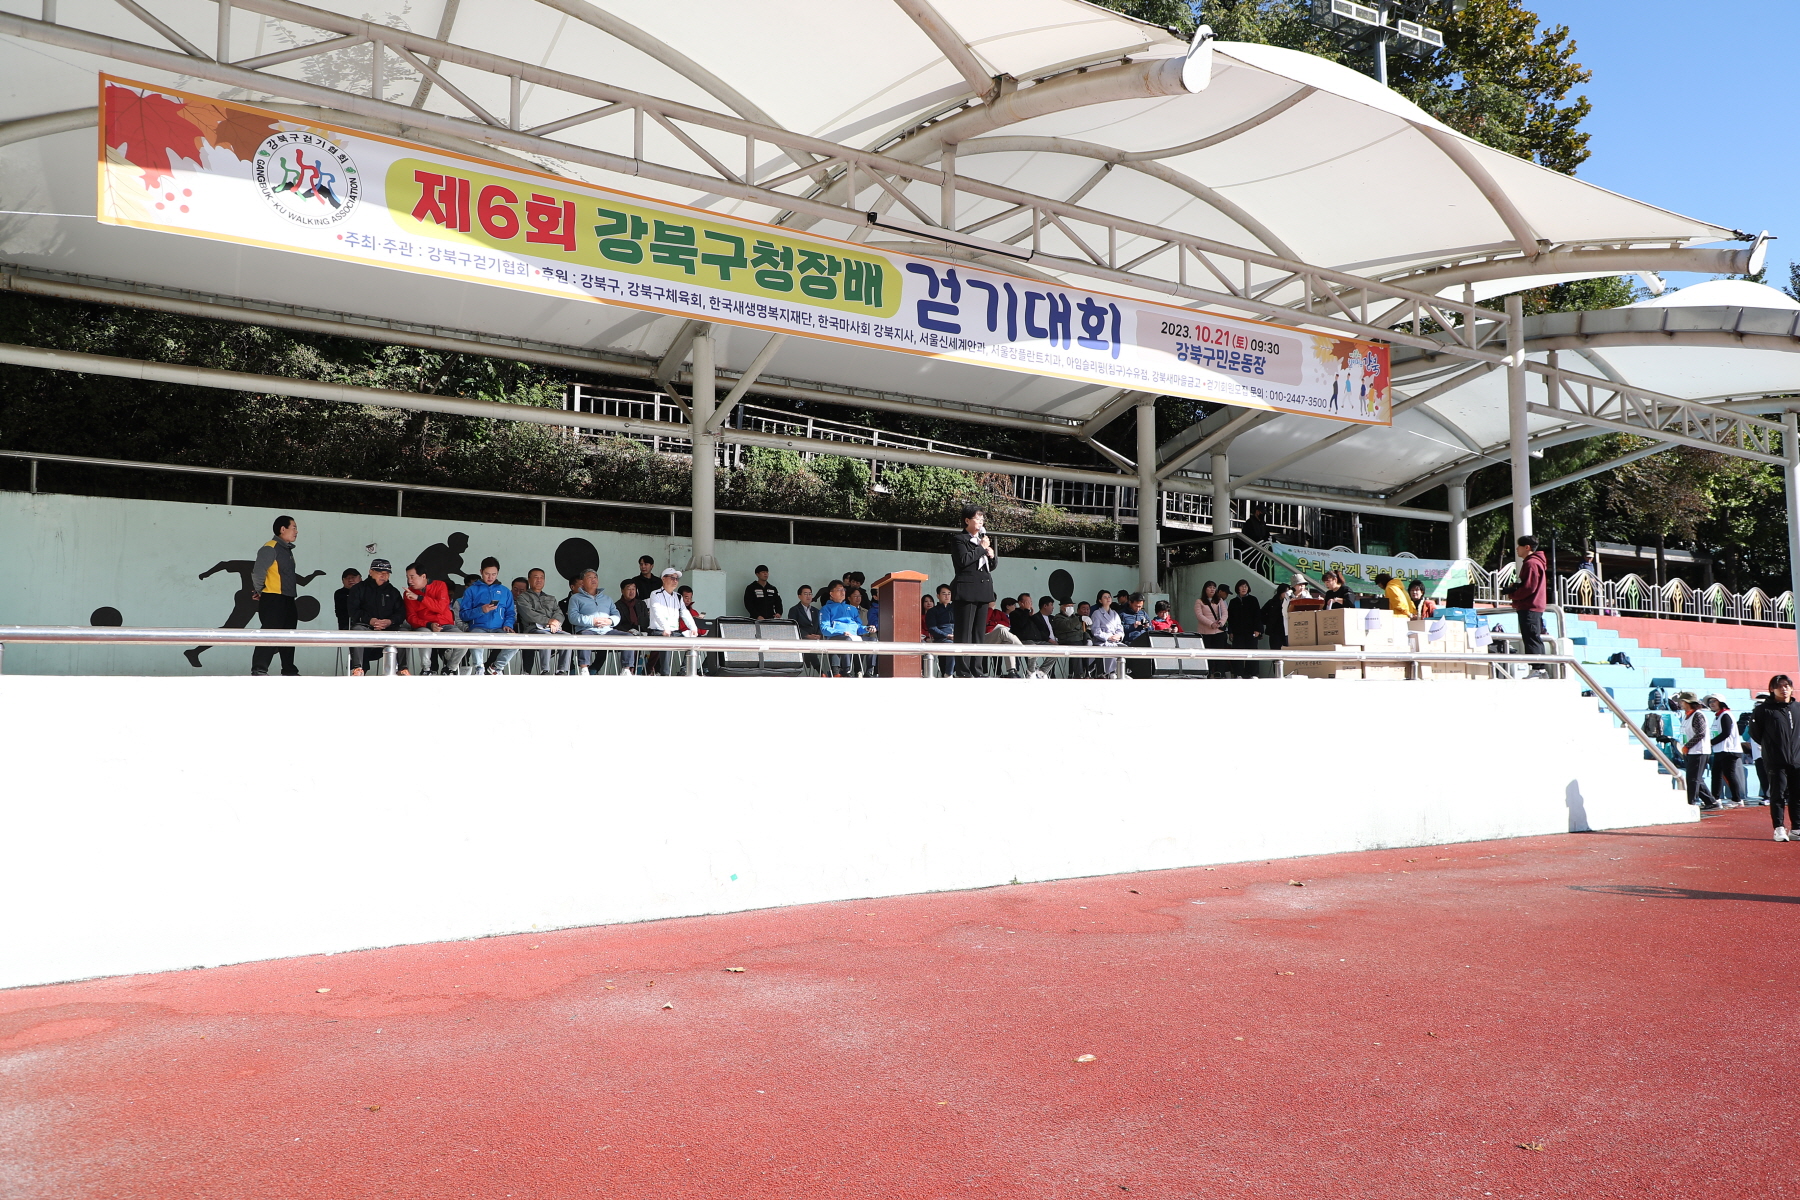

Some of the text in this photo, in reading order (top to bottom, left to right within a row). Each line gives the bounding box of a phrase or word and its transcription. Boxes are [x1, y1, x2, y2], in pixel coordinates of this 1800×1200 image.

[266, 133, 349, 164] 강북구걷기협회
[256, 158, 359, 226] GANGBUK-KU WALKING ASSOCIATION
[411, 169, 1122, 360] 제6회 강북구청장배 걷기대회
[427, 246, 530, 277] 강북구걷기협회
[541, 266, 569, 284] 후원
[580, 273, 624, 296] 강북구,
[627, 281, 706, 310] 강북구체육회,
[709, 296, 815, 328] 한국새생명복지재단,
[818, 314, 871, 336] 한국마사회
[873, 324, 917, 345] 강북지사,
[1250, 386, 1264, 399] 문의
[1269, 390, 1328, 409] 010-2447-3500
[1161, 321, 1192, 339] 2023.
[1251, 339, 1280, 355] 09:30
[1175, 341, 1266, 375] 강북구민운동장
[1296, 558, 1325, 575] 우리
